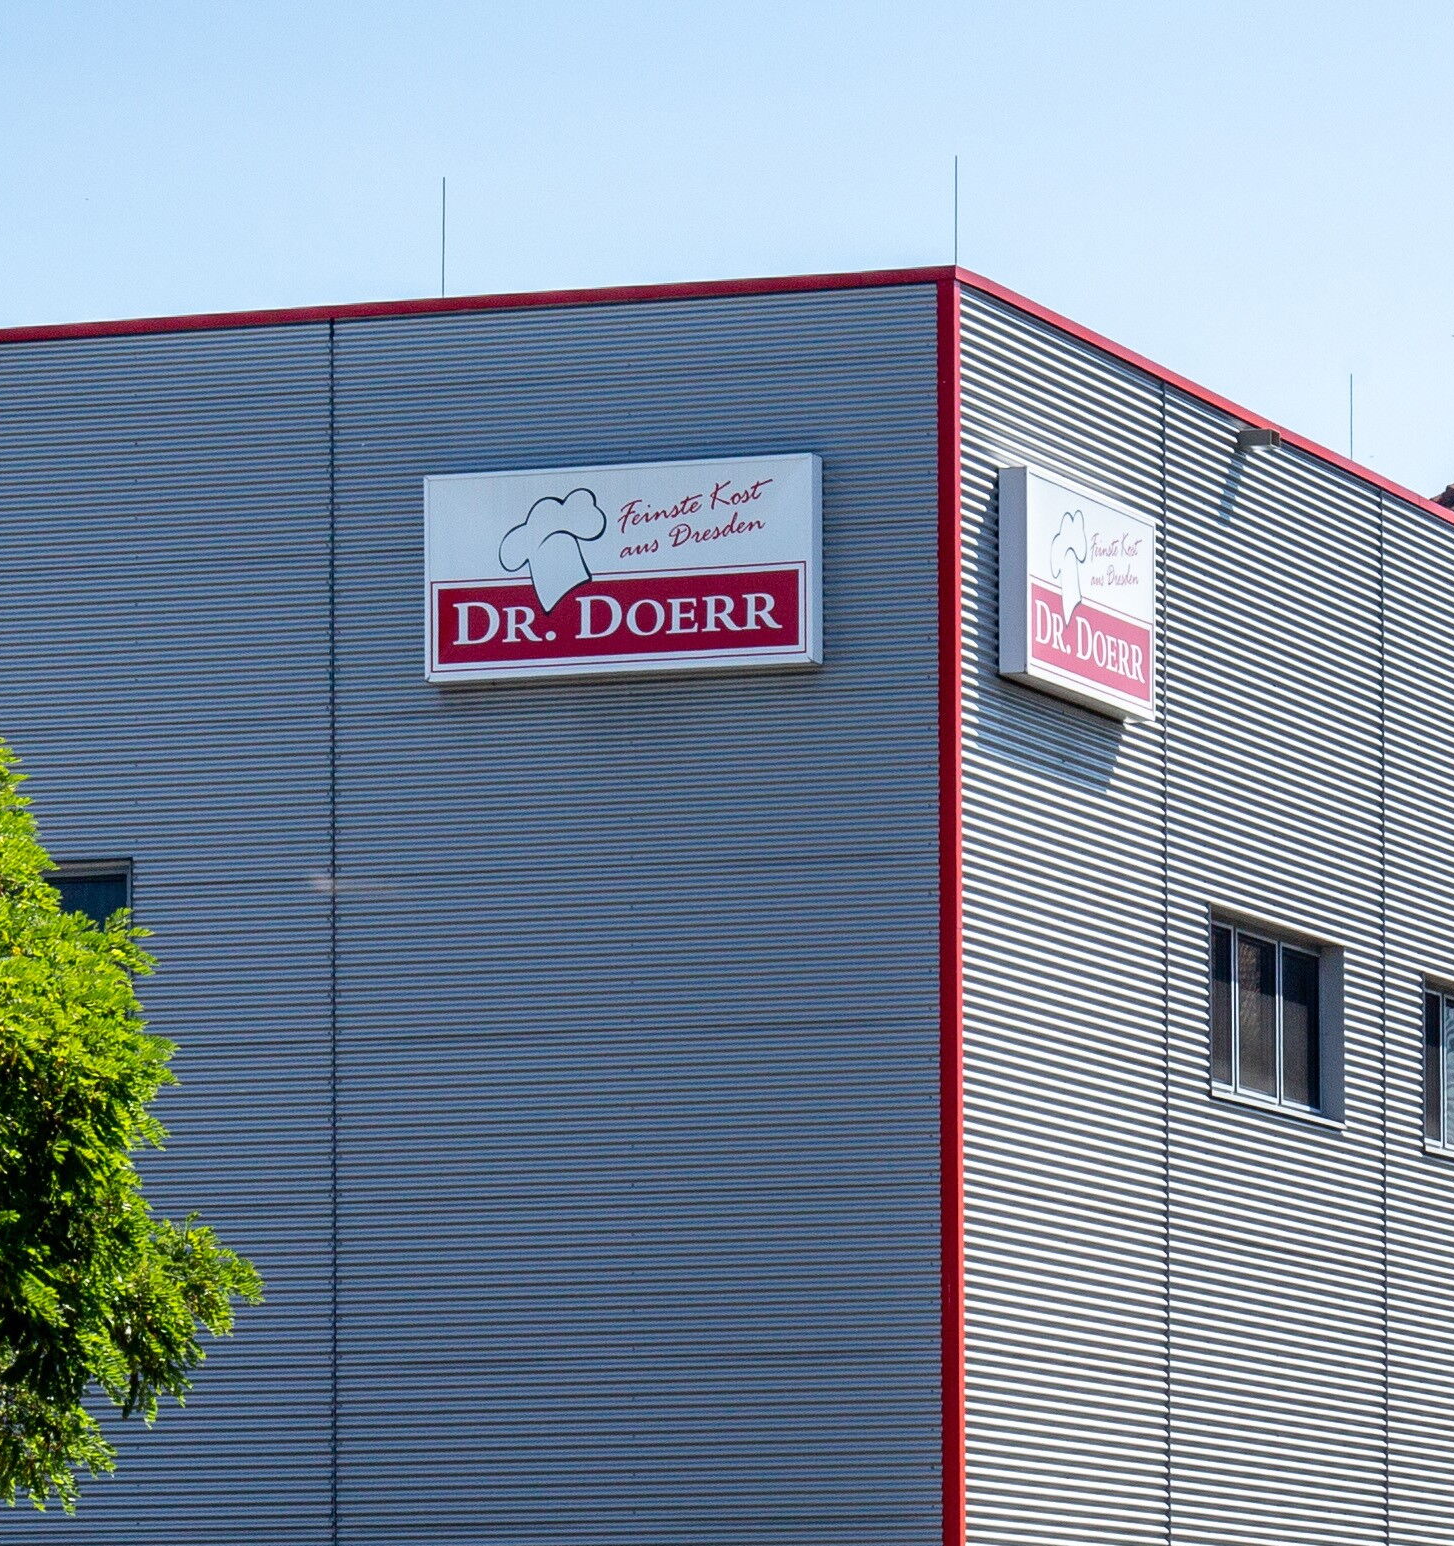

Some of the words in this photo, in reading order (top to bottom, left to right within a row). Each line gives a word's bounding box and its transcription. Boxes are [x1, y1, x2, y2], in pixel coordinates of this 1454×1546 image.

[617, 493, 703, 534] Feinste
[710, 478, 774, 510] Kost
[619, 539, 660, 559] aus
[668, 511, 766, 548] Dresden
[1090, 532, 1119, 564] Feinste
[1106, 564, 1139, 586] Dresden
[452, 601, 557, 646] DR.
[575, 591, 783, 640] DOERR
[1034, 599, 1072, 655] DR.
[1075, 616, 1146, 685] DOERR
